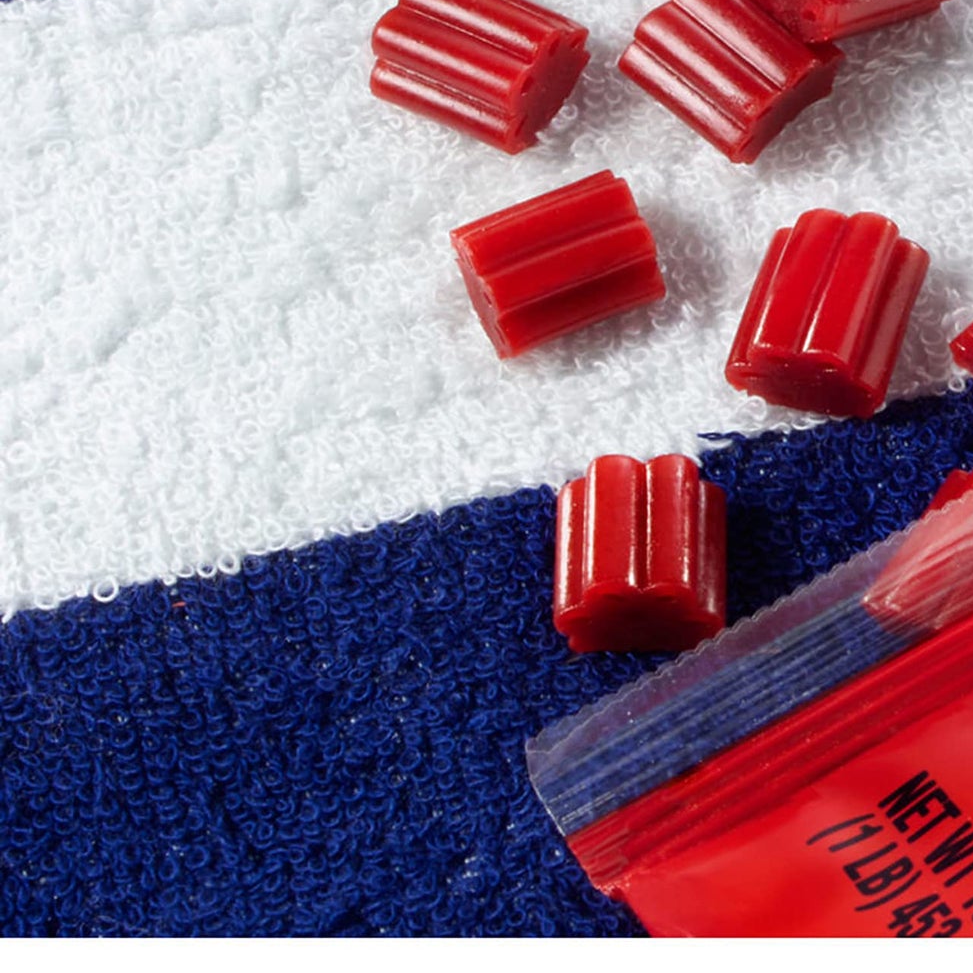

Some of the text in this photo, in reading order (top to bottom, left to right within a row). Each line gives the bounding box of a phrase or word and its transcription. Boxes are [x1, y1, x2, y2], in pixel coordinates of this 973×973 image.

[806, 813, 884, 853] (1
[877, 770, 961, 844] NET
[843, 842, 922, 912] LB)
